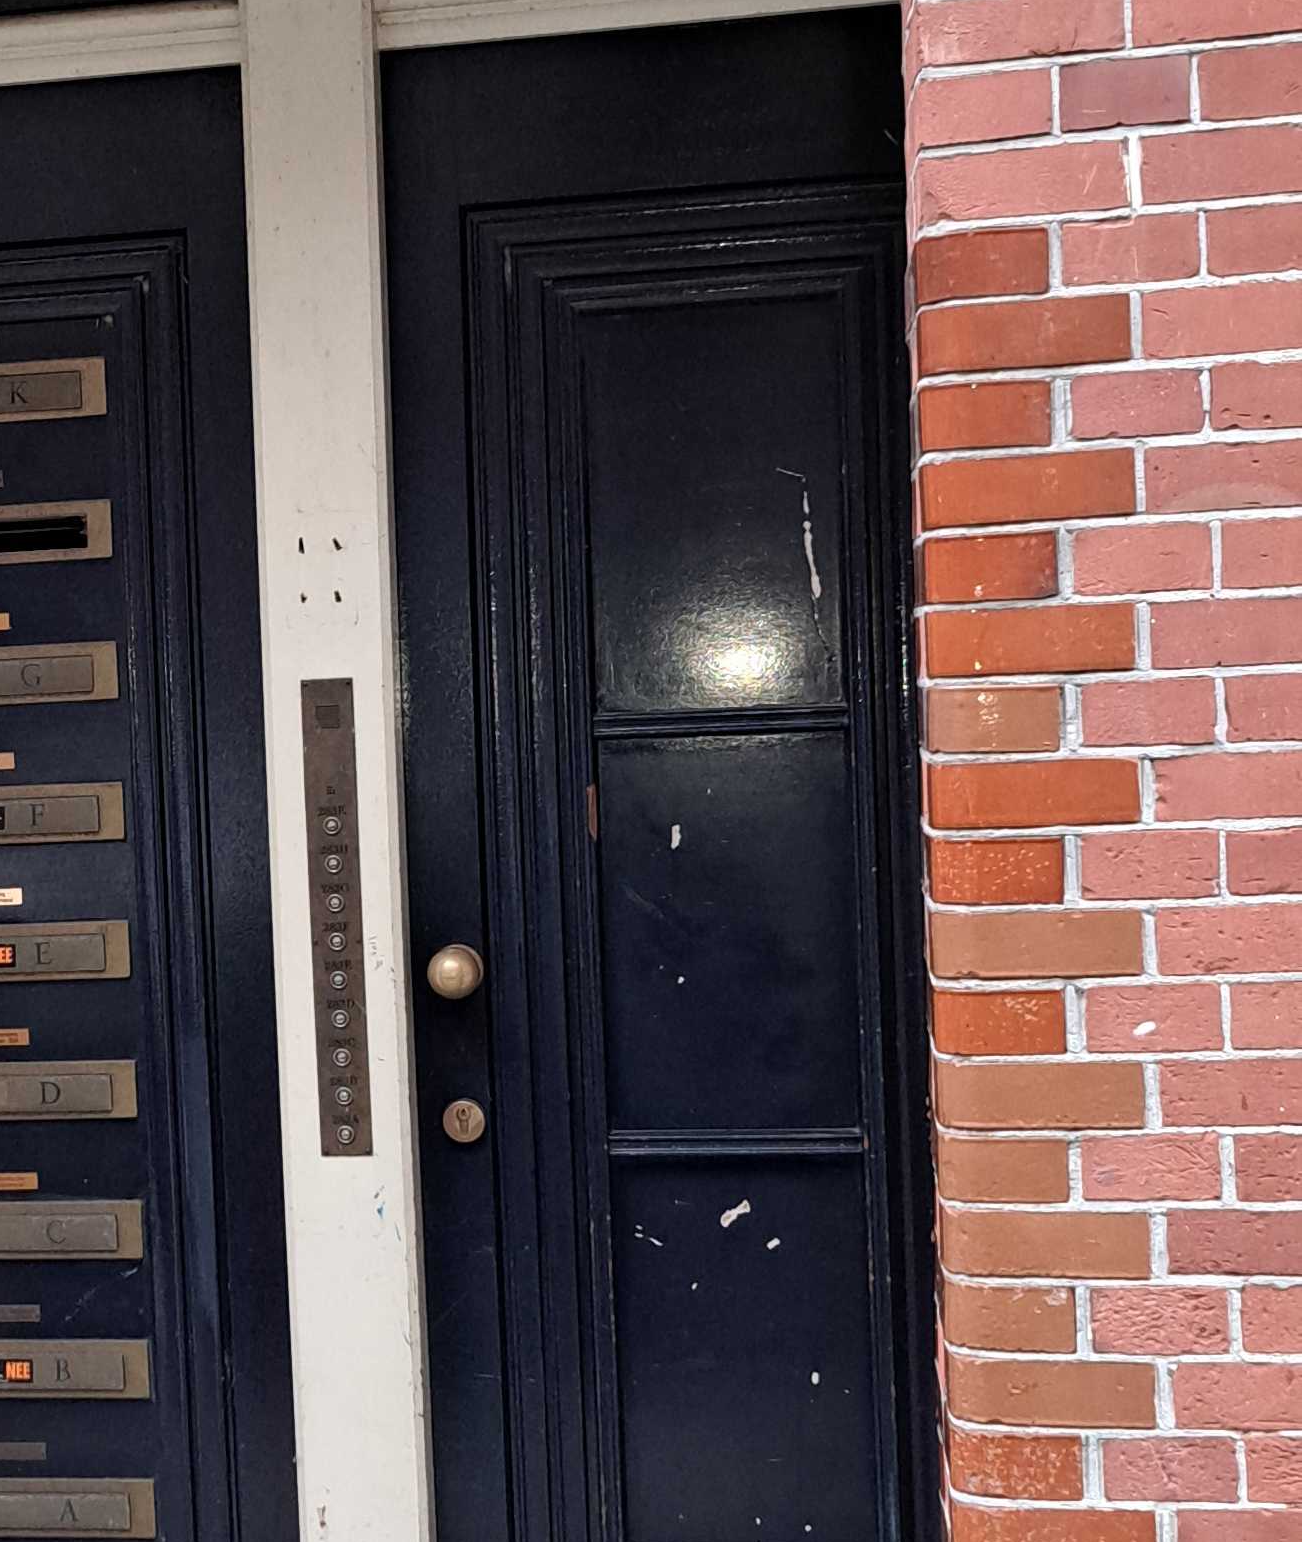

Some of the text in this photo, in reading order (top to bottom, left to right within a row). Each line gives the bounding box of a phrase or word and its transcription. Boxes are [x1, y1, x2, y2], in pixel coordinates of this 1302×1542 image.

[10, 381, 28, 404] K
[21, 664, 41, 687] G
[30, 803, 45, 826] F
[35, 942, 52, 965] E
[40, 1081, 60, 1104] D
[47, 1220, 67, 1244] C
[6, 1361, 30, 1379] NEE
[56, 1359, 71, 1381] B
[60, 1499, 78, 1521] A
